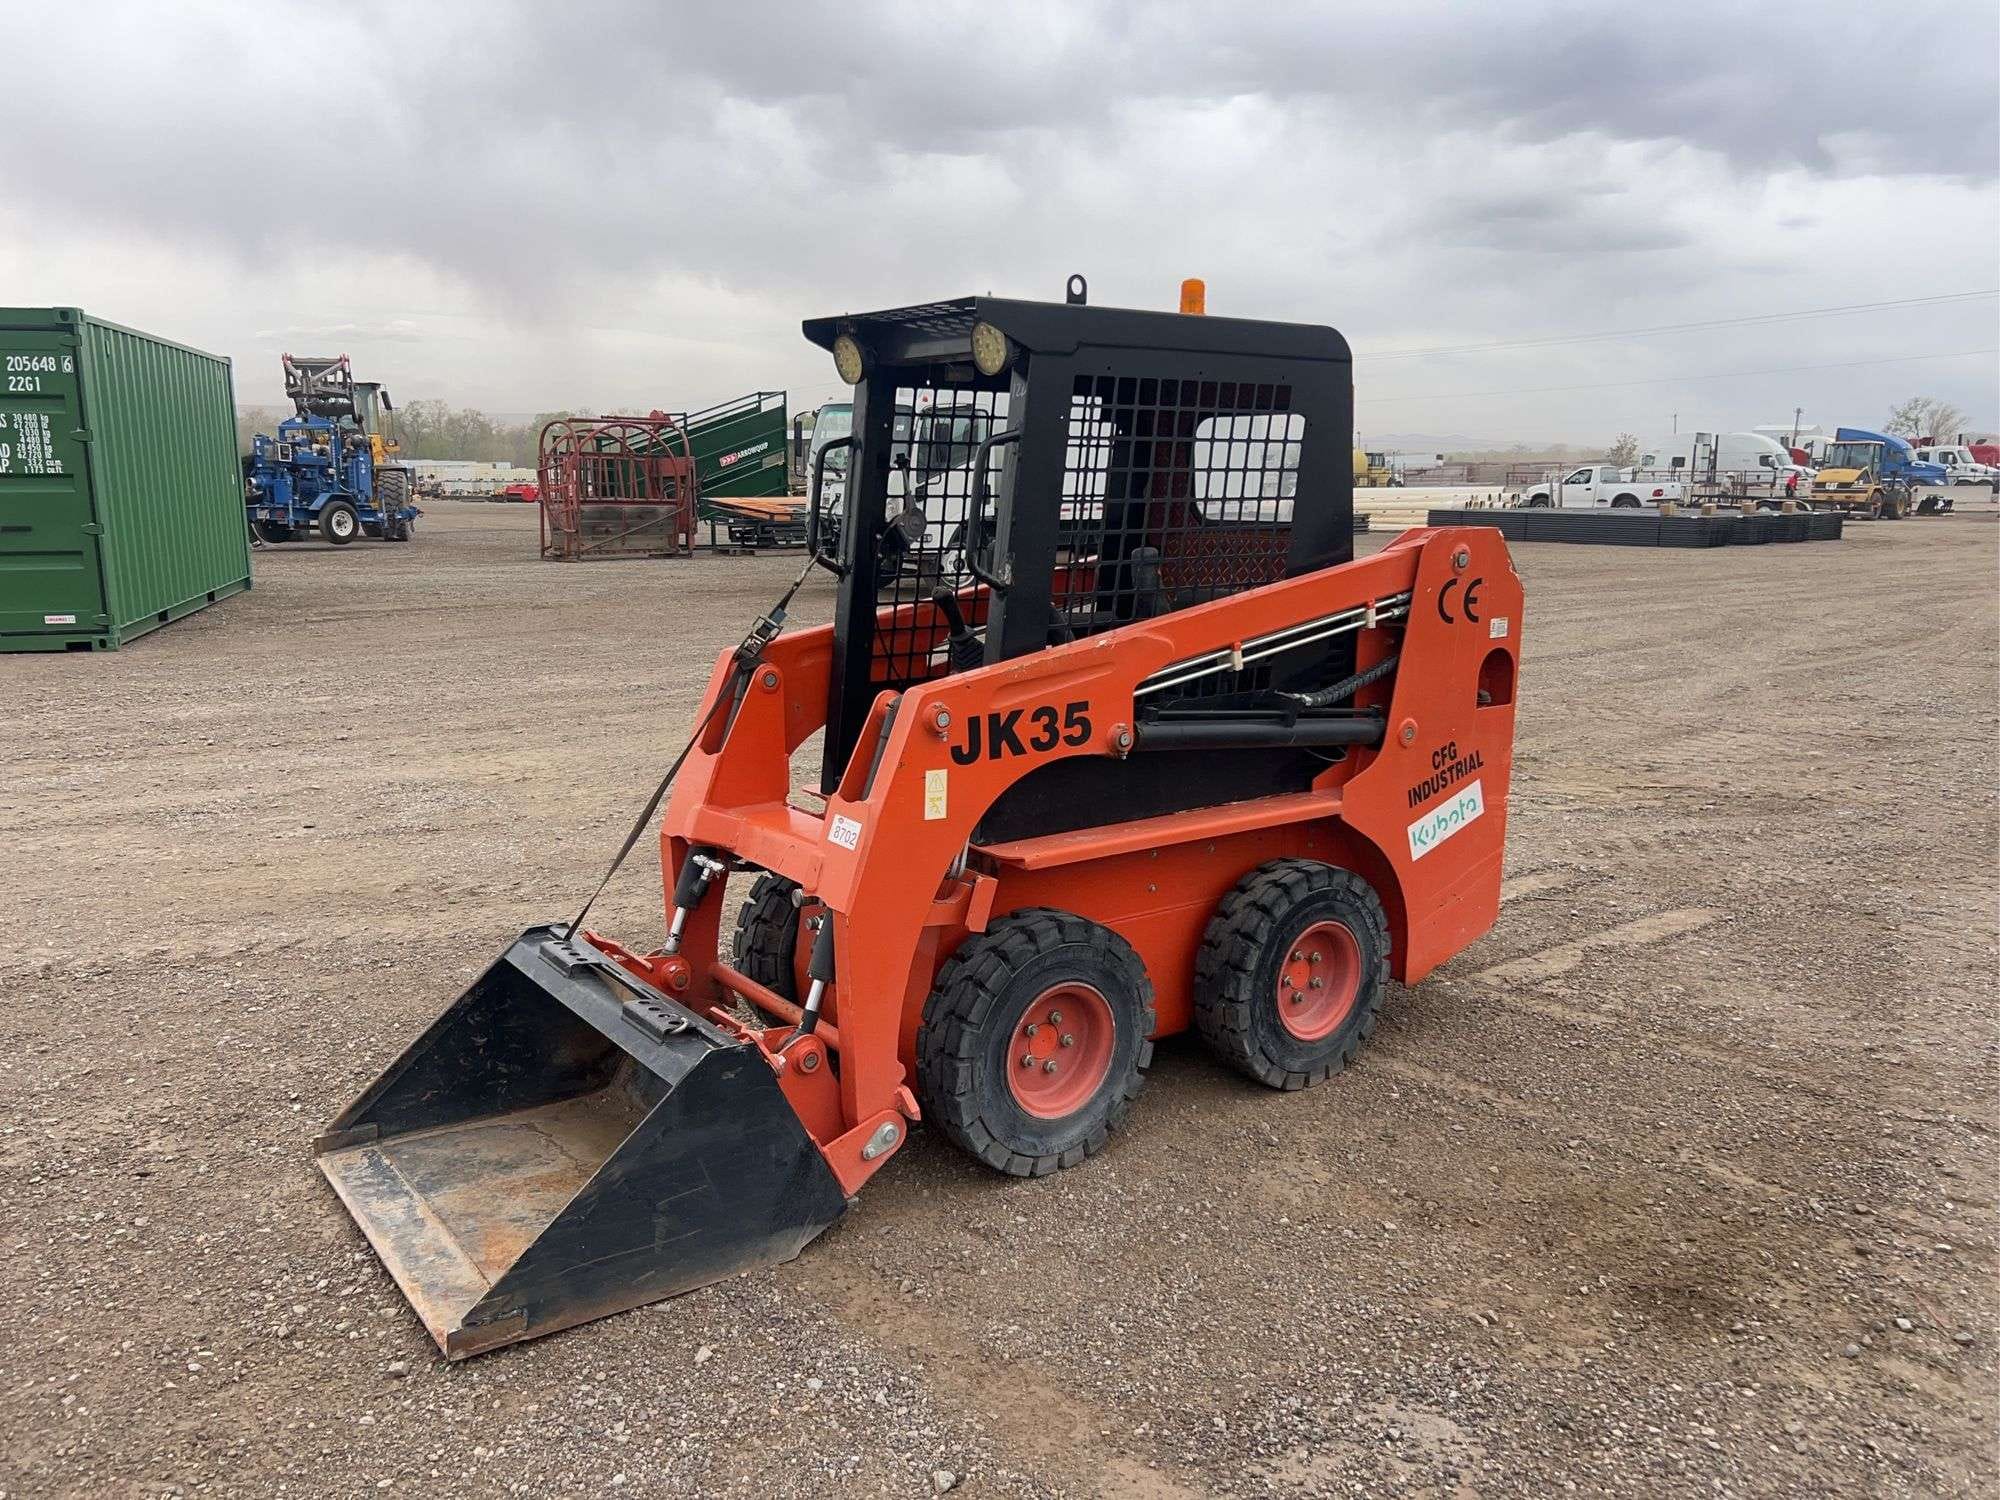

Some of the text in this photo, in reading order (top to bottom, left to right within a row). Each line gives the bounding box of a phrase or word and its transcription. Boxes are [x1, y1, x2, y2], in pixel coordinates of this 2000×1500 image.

[6, 356, 72, 373] 205648 6
[8, 376, 41, 392] 22G1
[950, 700, 1092, 766] JK35
[1432, 740, 1457, 770] CFG
[1408, 750, 1484, 808] INDUSTRIAL
[833, 825, 857, 847] 8702
[1412, 798, 1477, 847] Kubota
